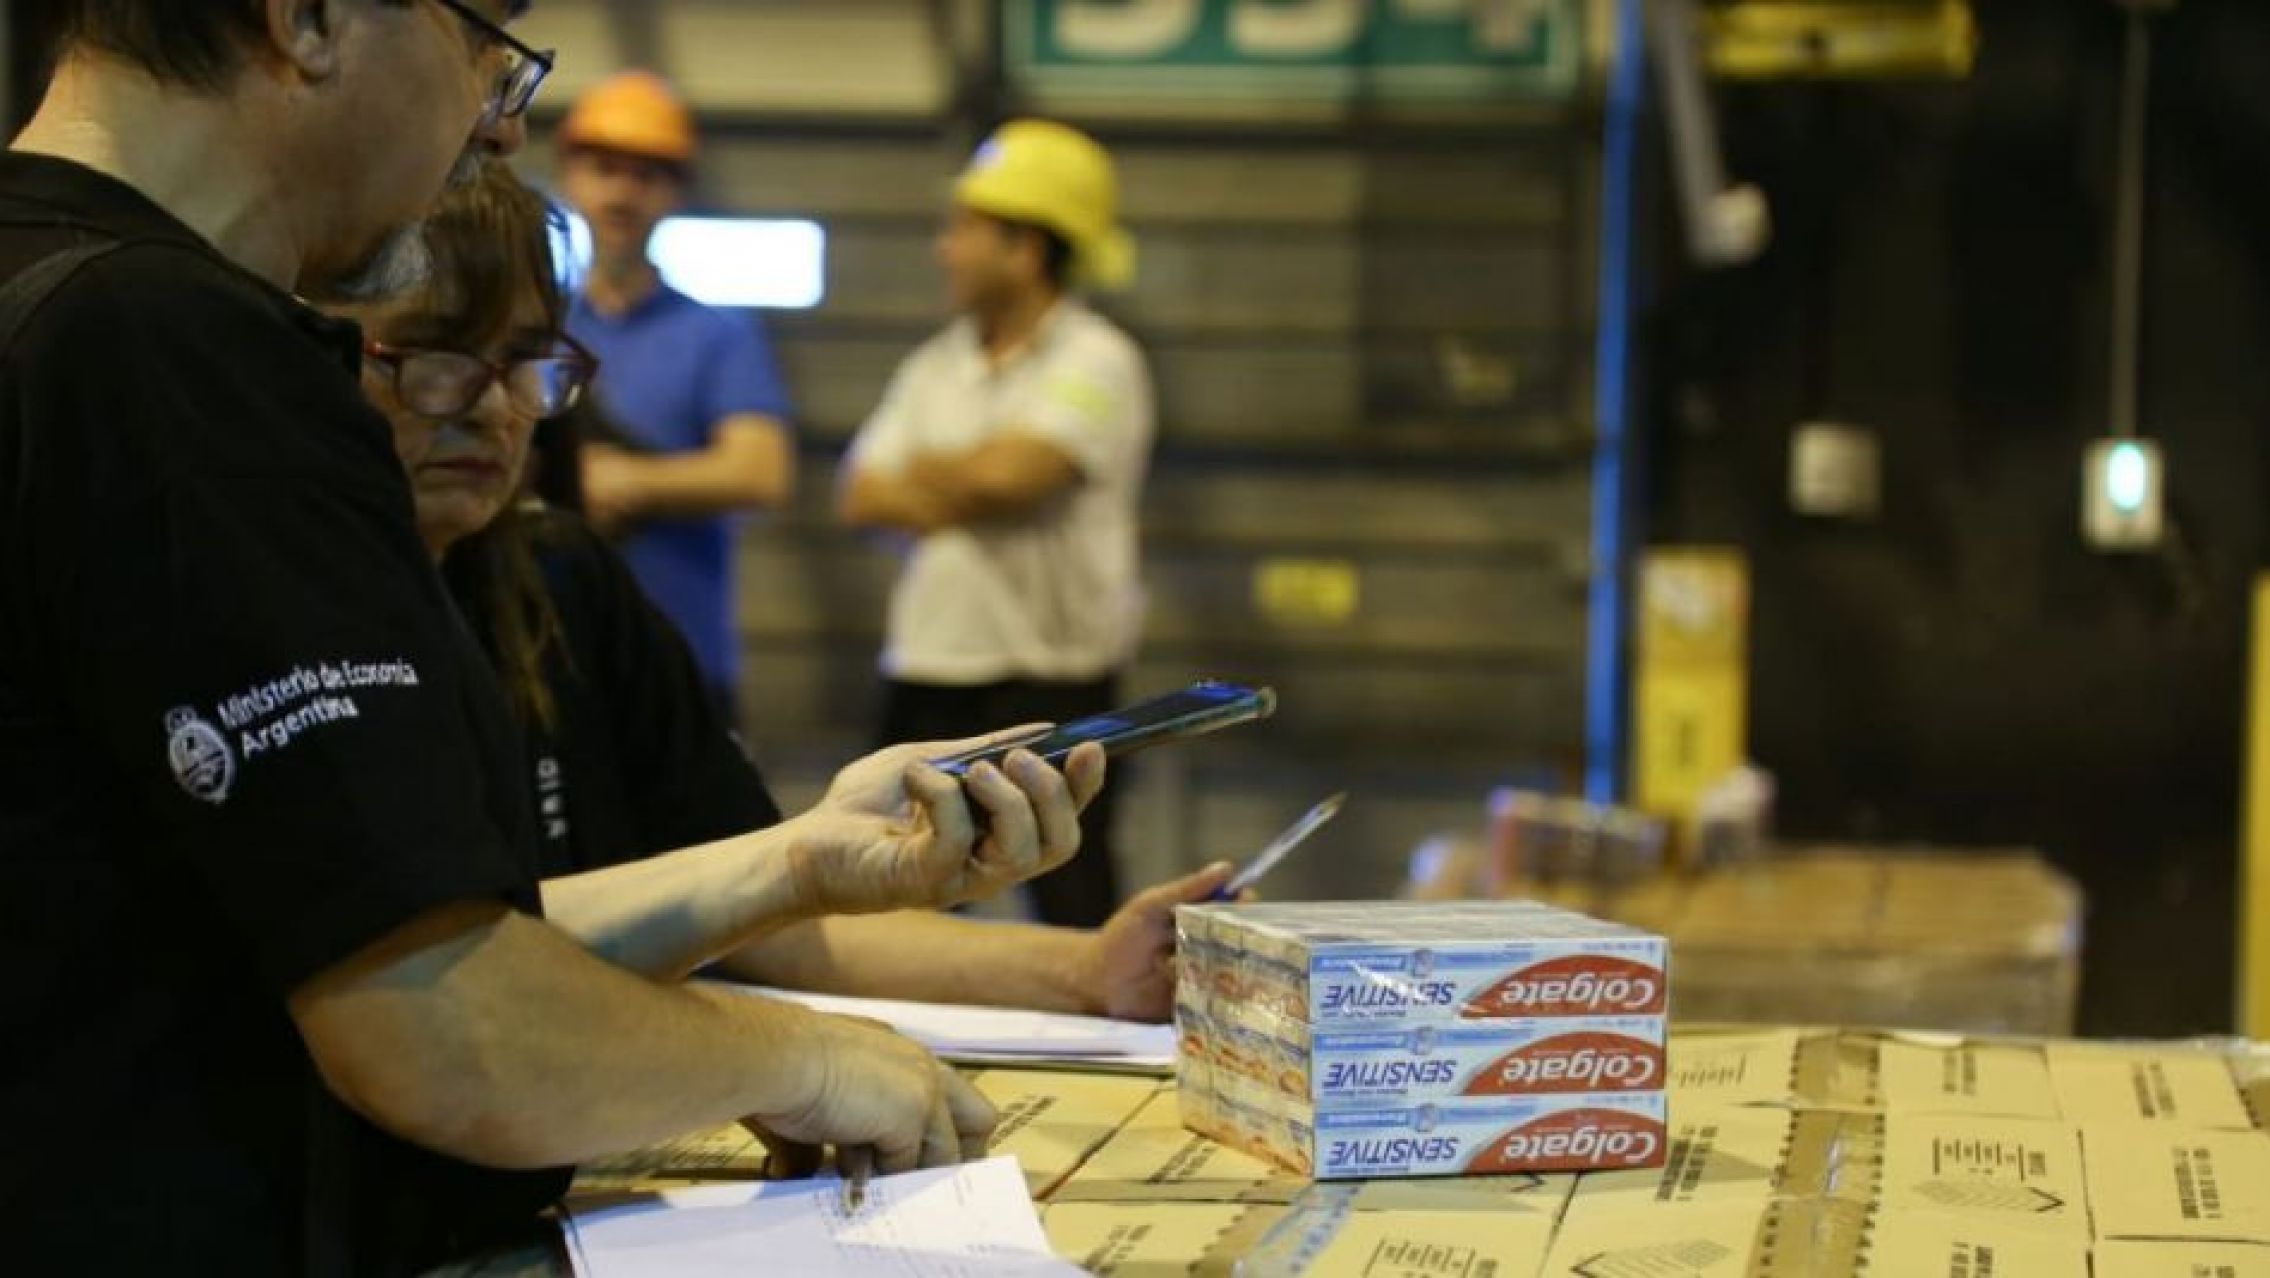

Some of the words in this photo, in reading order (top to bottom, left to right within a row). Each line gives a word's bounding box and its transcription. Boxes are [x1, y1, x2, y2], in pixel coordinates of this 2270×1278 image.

[218, 665, 320, 728] Ministerio
[320, 662, 345, 689] de
[242, 696, 359, 760] Argentina
[1502, 972, 1655, 1010] Colgate
[1322, 1060, 1457, 1088] SENSITIVE
[1503, 1050, 1655, 1087] Colgate
[1326, 1137, 1460, 1166] SENSITIVE
[1504, 1126, 1656, 1165] Colgate
